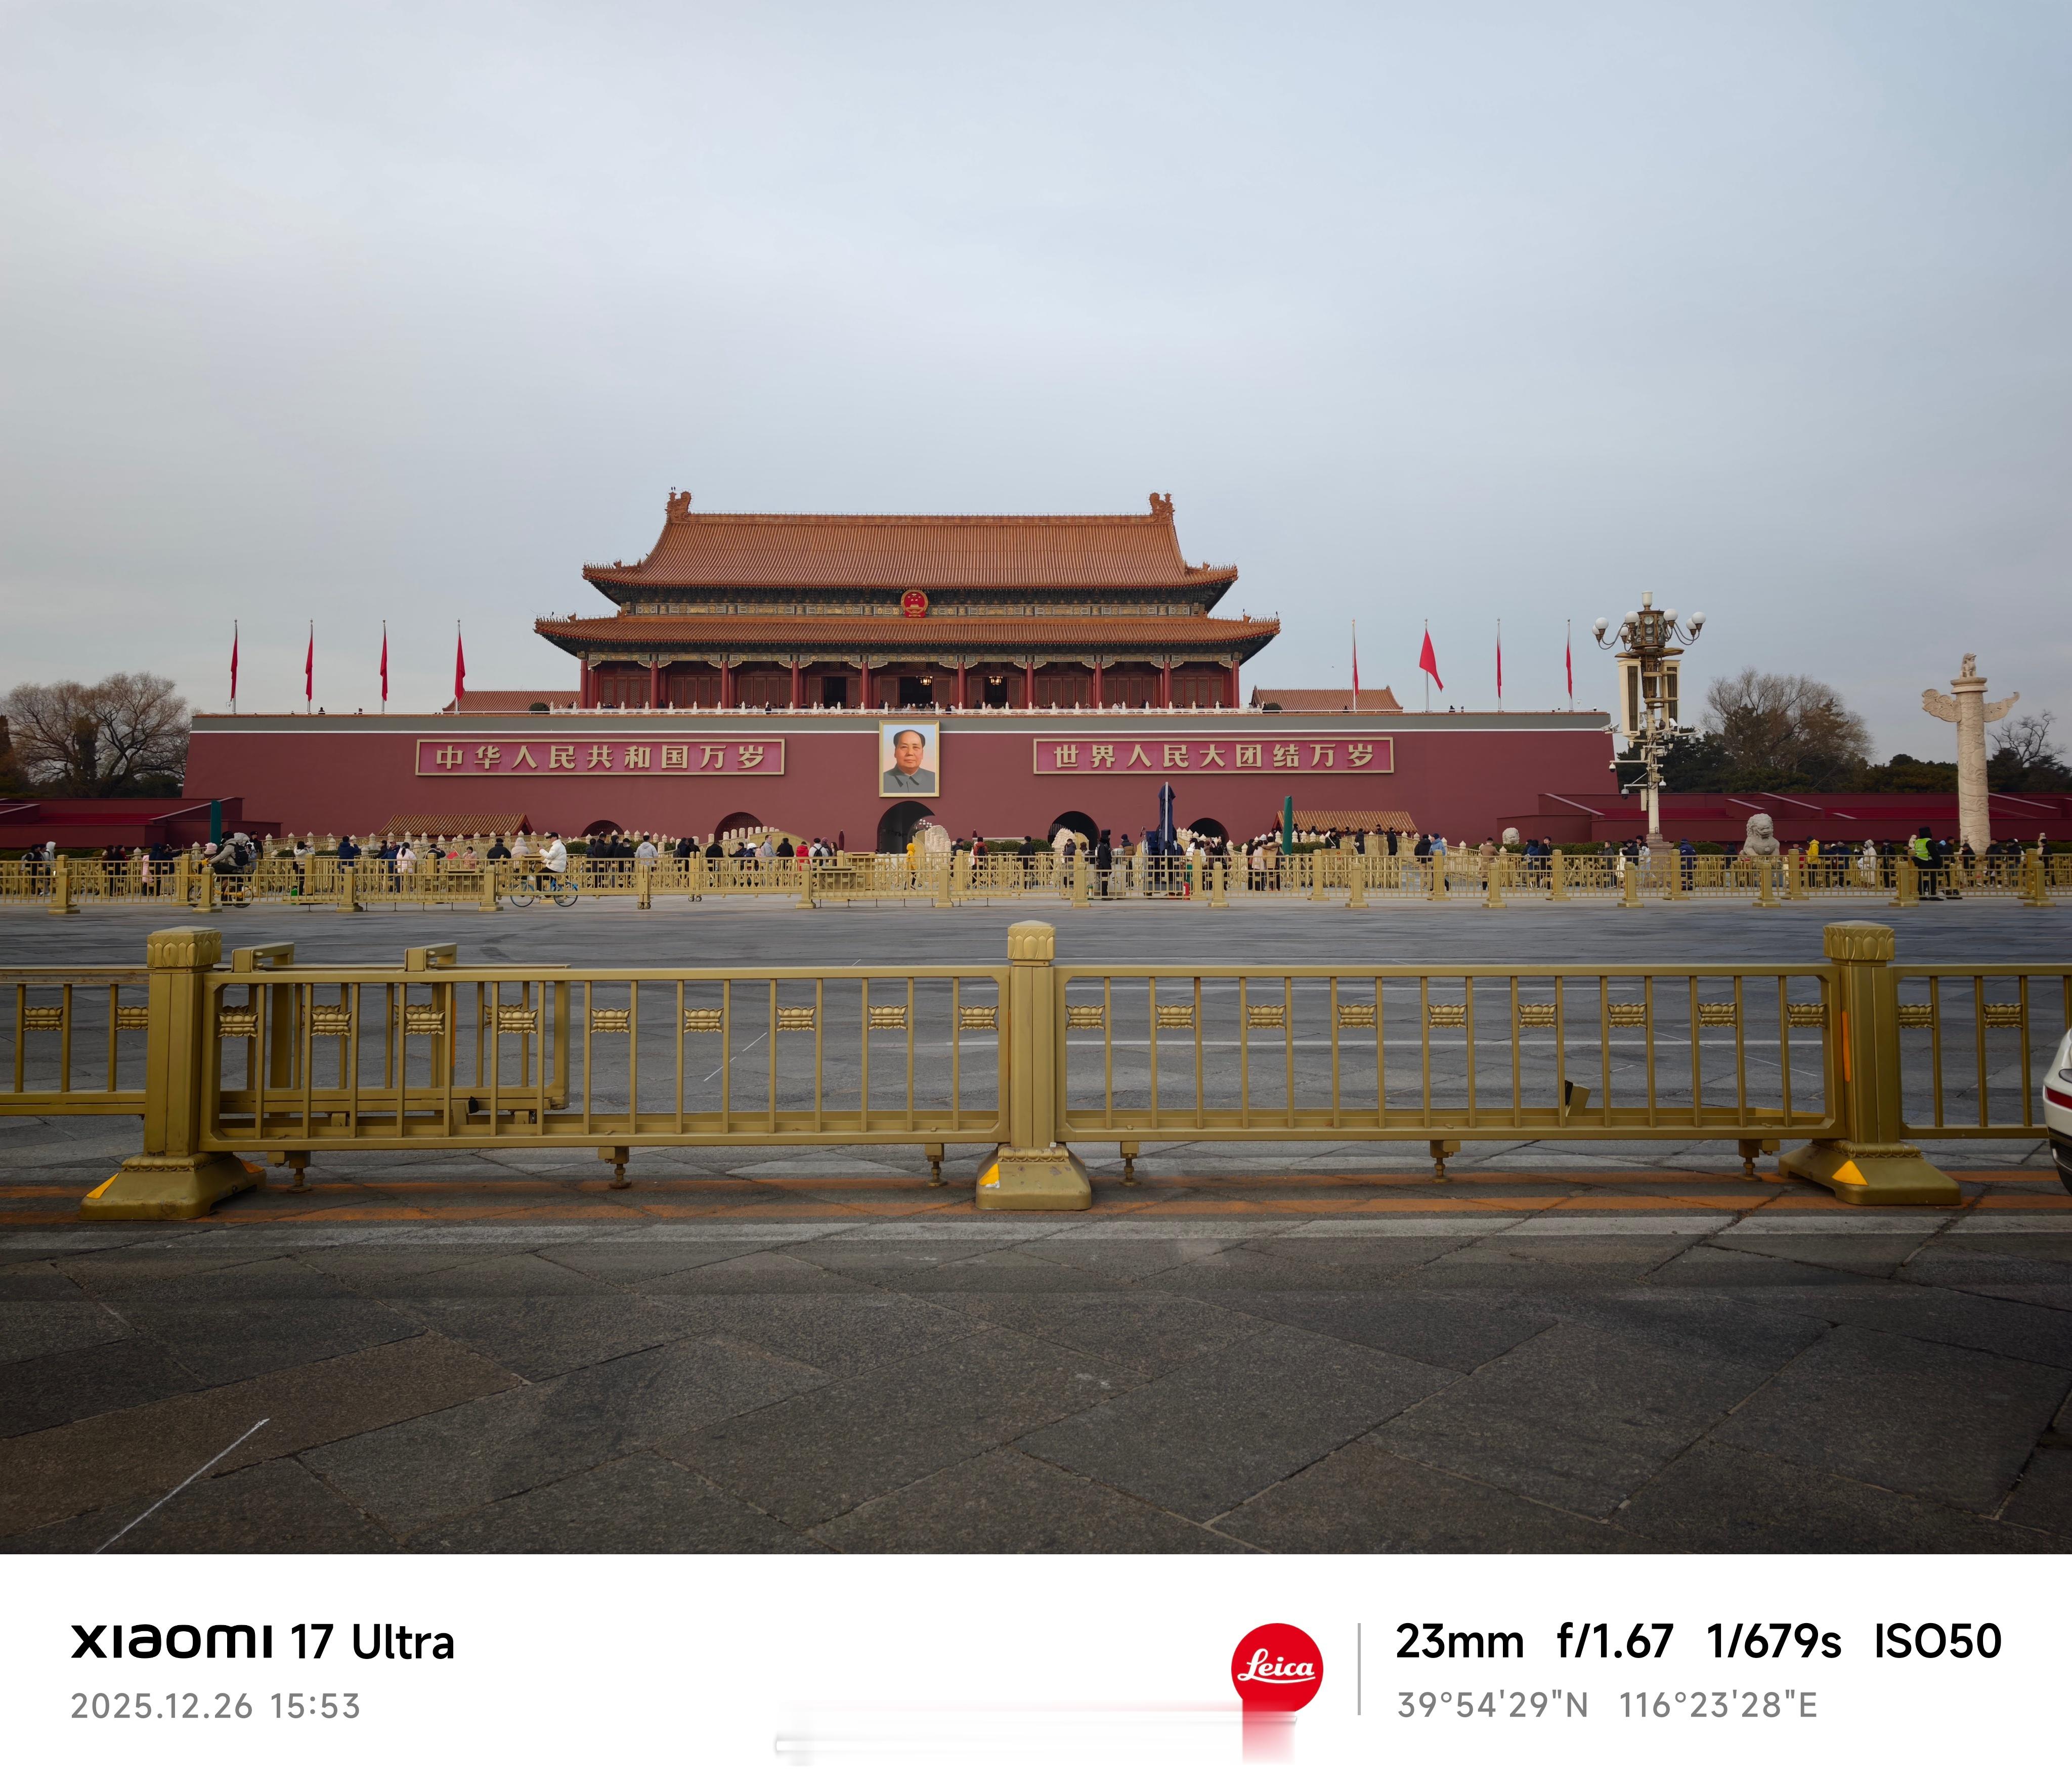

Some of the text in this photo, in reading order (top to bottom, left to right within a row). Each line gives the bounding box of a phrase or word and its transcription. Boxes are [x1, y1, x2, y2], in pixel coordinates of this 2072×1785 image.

[436, 744, 764, 770] 中华人民共和国万岁
[1053, 743, 1374, 768] 世界人民大团结万岁
